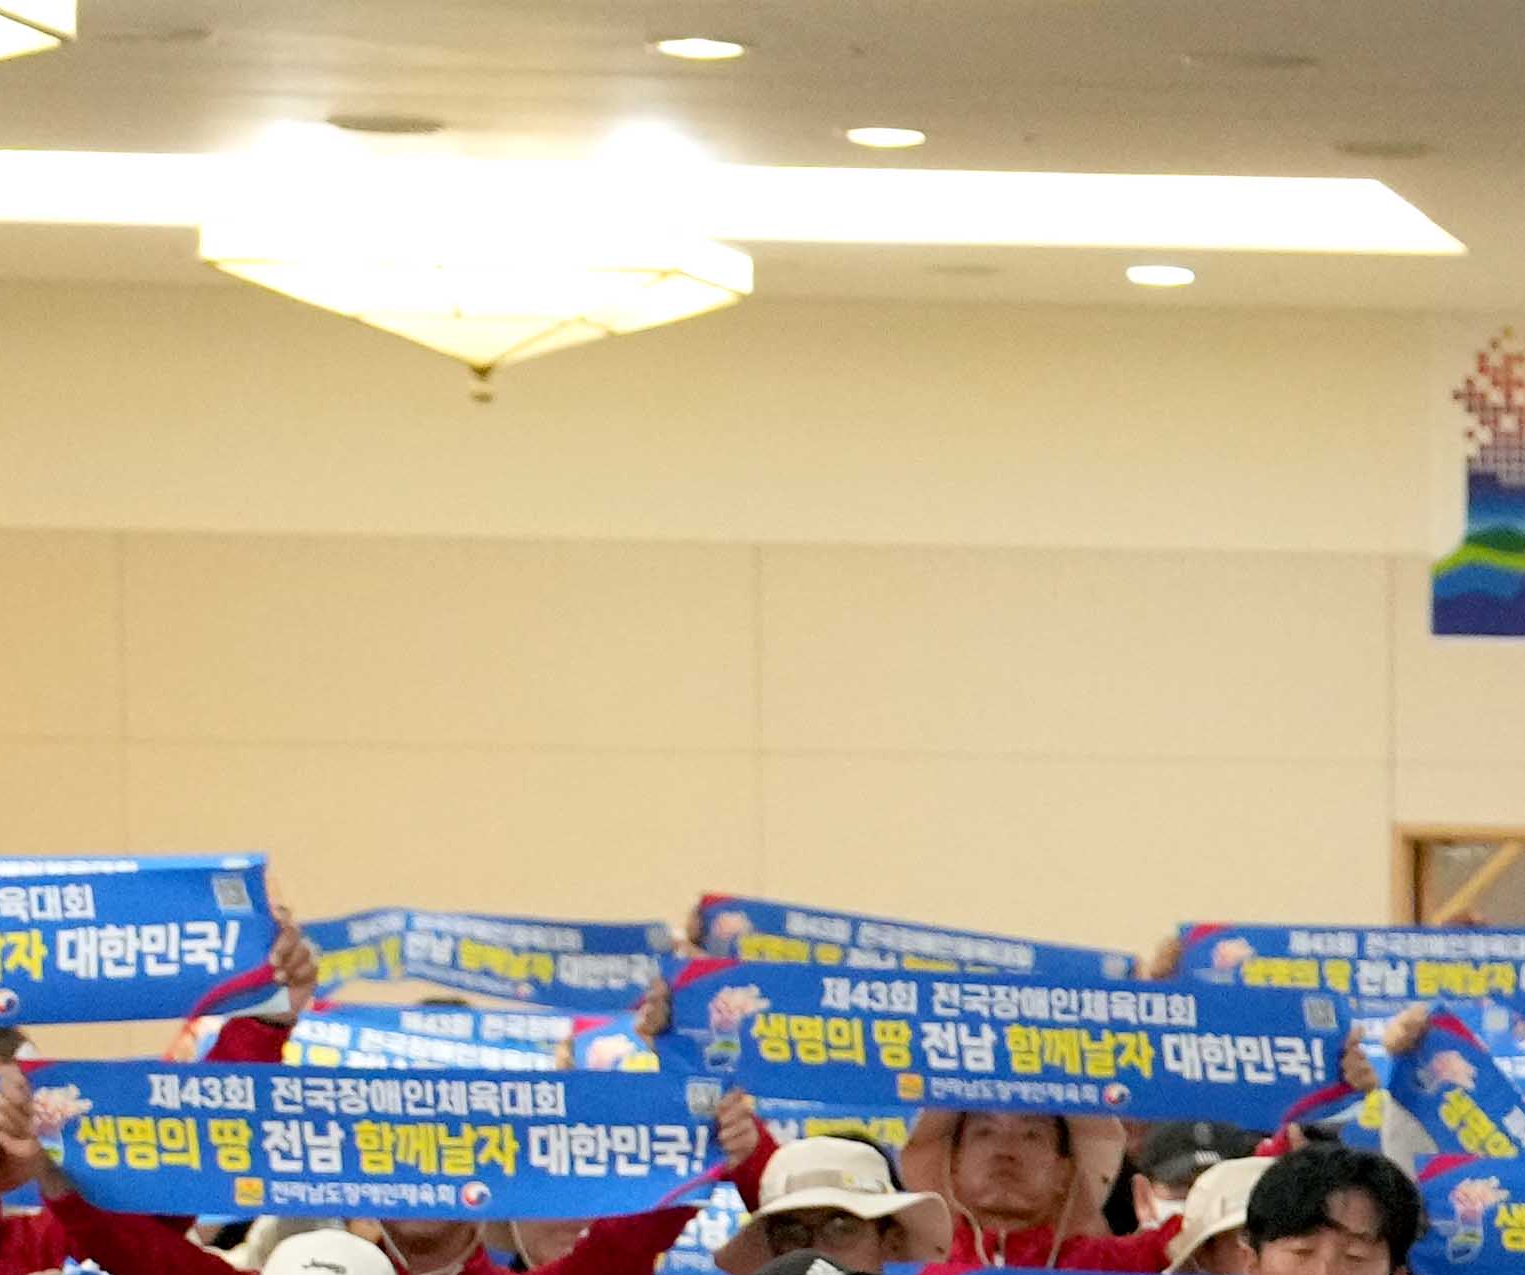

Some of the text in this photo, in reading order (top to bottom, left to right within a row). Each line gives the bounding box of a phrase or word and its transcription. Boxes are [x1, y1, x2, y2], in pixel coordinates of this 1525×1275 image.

[56, 921, 247, 984] 대한민국!
[821, 978, 1196, 1026] 제43회 전국장애인체육대회
[744, 1006, 1324, 1084] 생명의 땅 전남 함께날자 대한민국!
